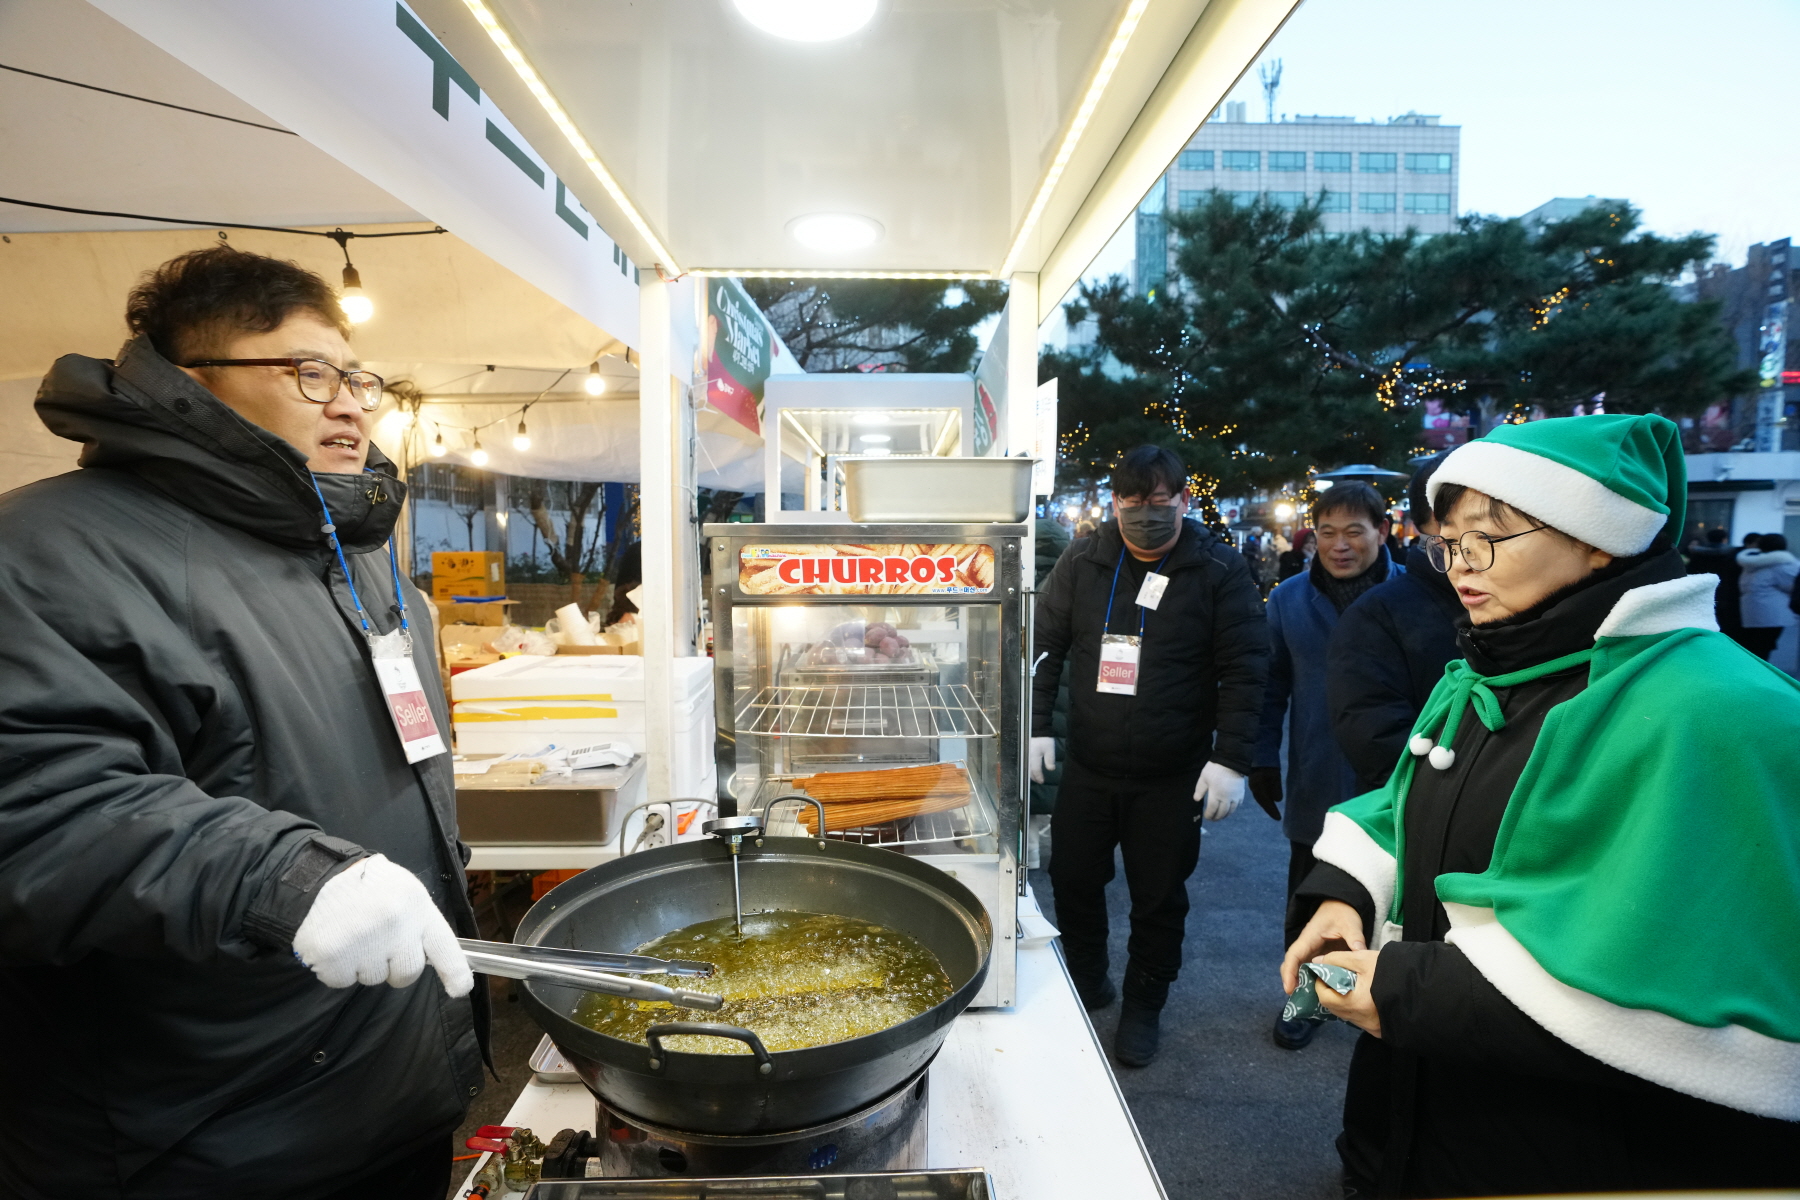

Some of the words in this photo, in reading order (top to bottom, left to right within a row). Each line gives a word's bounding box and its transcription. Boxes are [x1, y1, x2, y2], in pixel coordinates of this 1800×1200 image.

[778, 557, 956, 584] CHURROS
[1102, 665, 1134, 679] Seller
[395, 704, 429, 727] Seller
